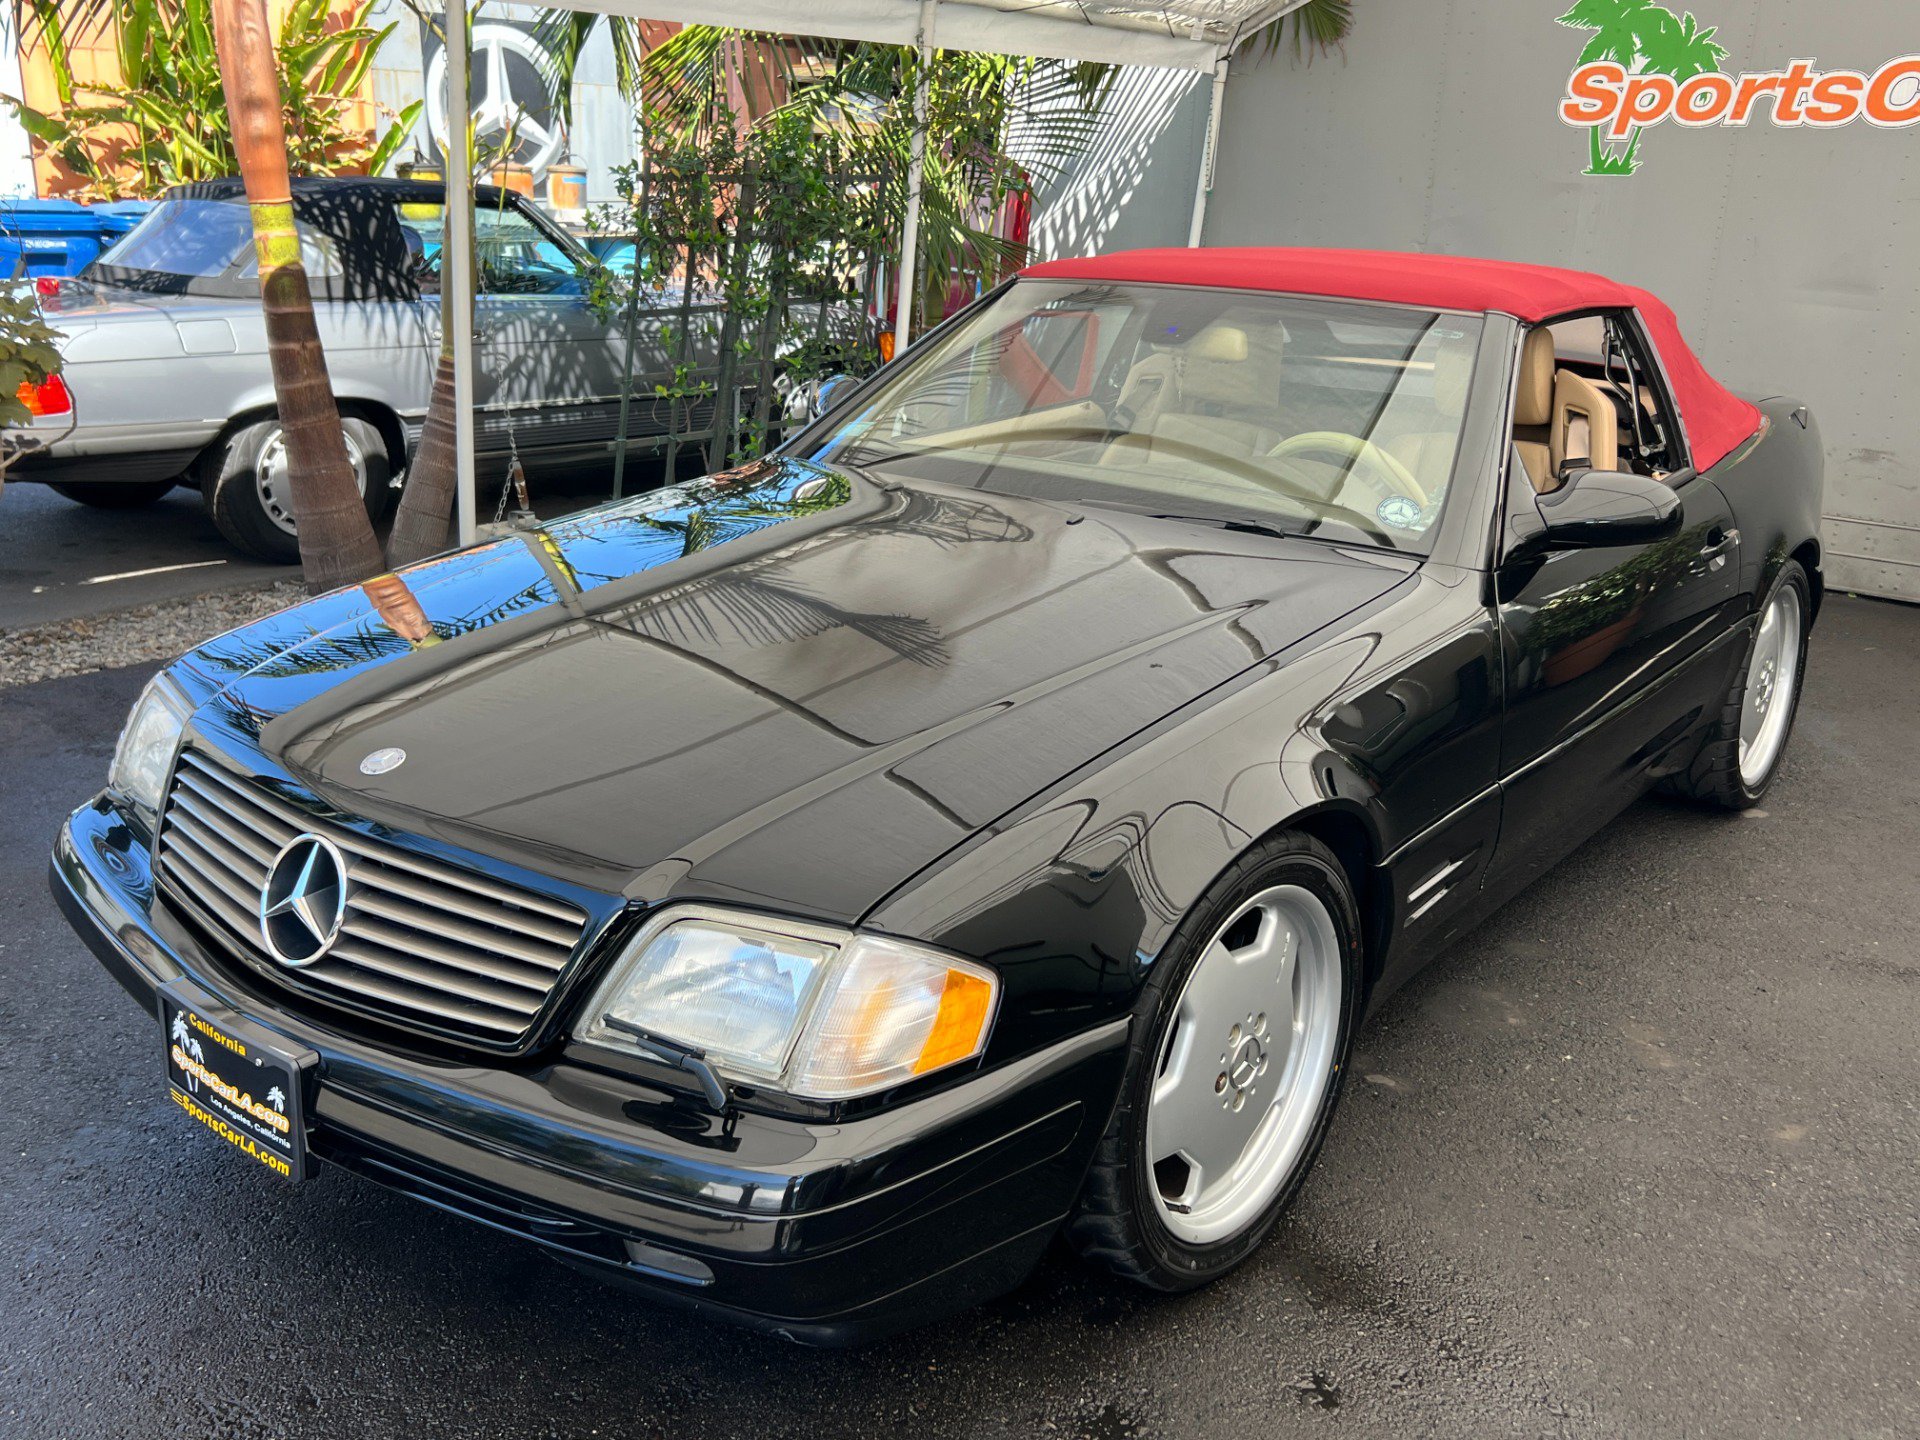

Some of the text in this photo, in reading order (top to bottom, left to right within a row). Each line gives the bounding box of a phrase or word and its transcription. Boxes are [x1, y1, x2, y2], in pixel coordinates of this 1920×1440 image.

[1560, 55, 1920, 139] SportsC
[189, 1013, 246, 1056] California
[172, 1045, 290, 1133] SportsCarLA.com
[210, 1095, 291, 1150] Los Angeles, California
[182, 1095, 290, 1177] SportsCarLA.com
